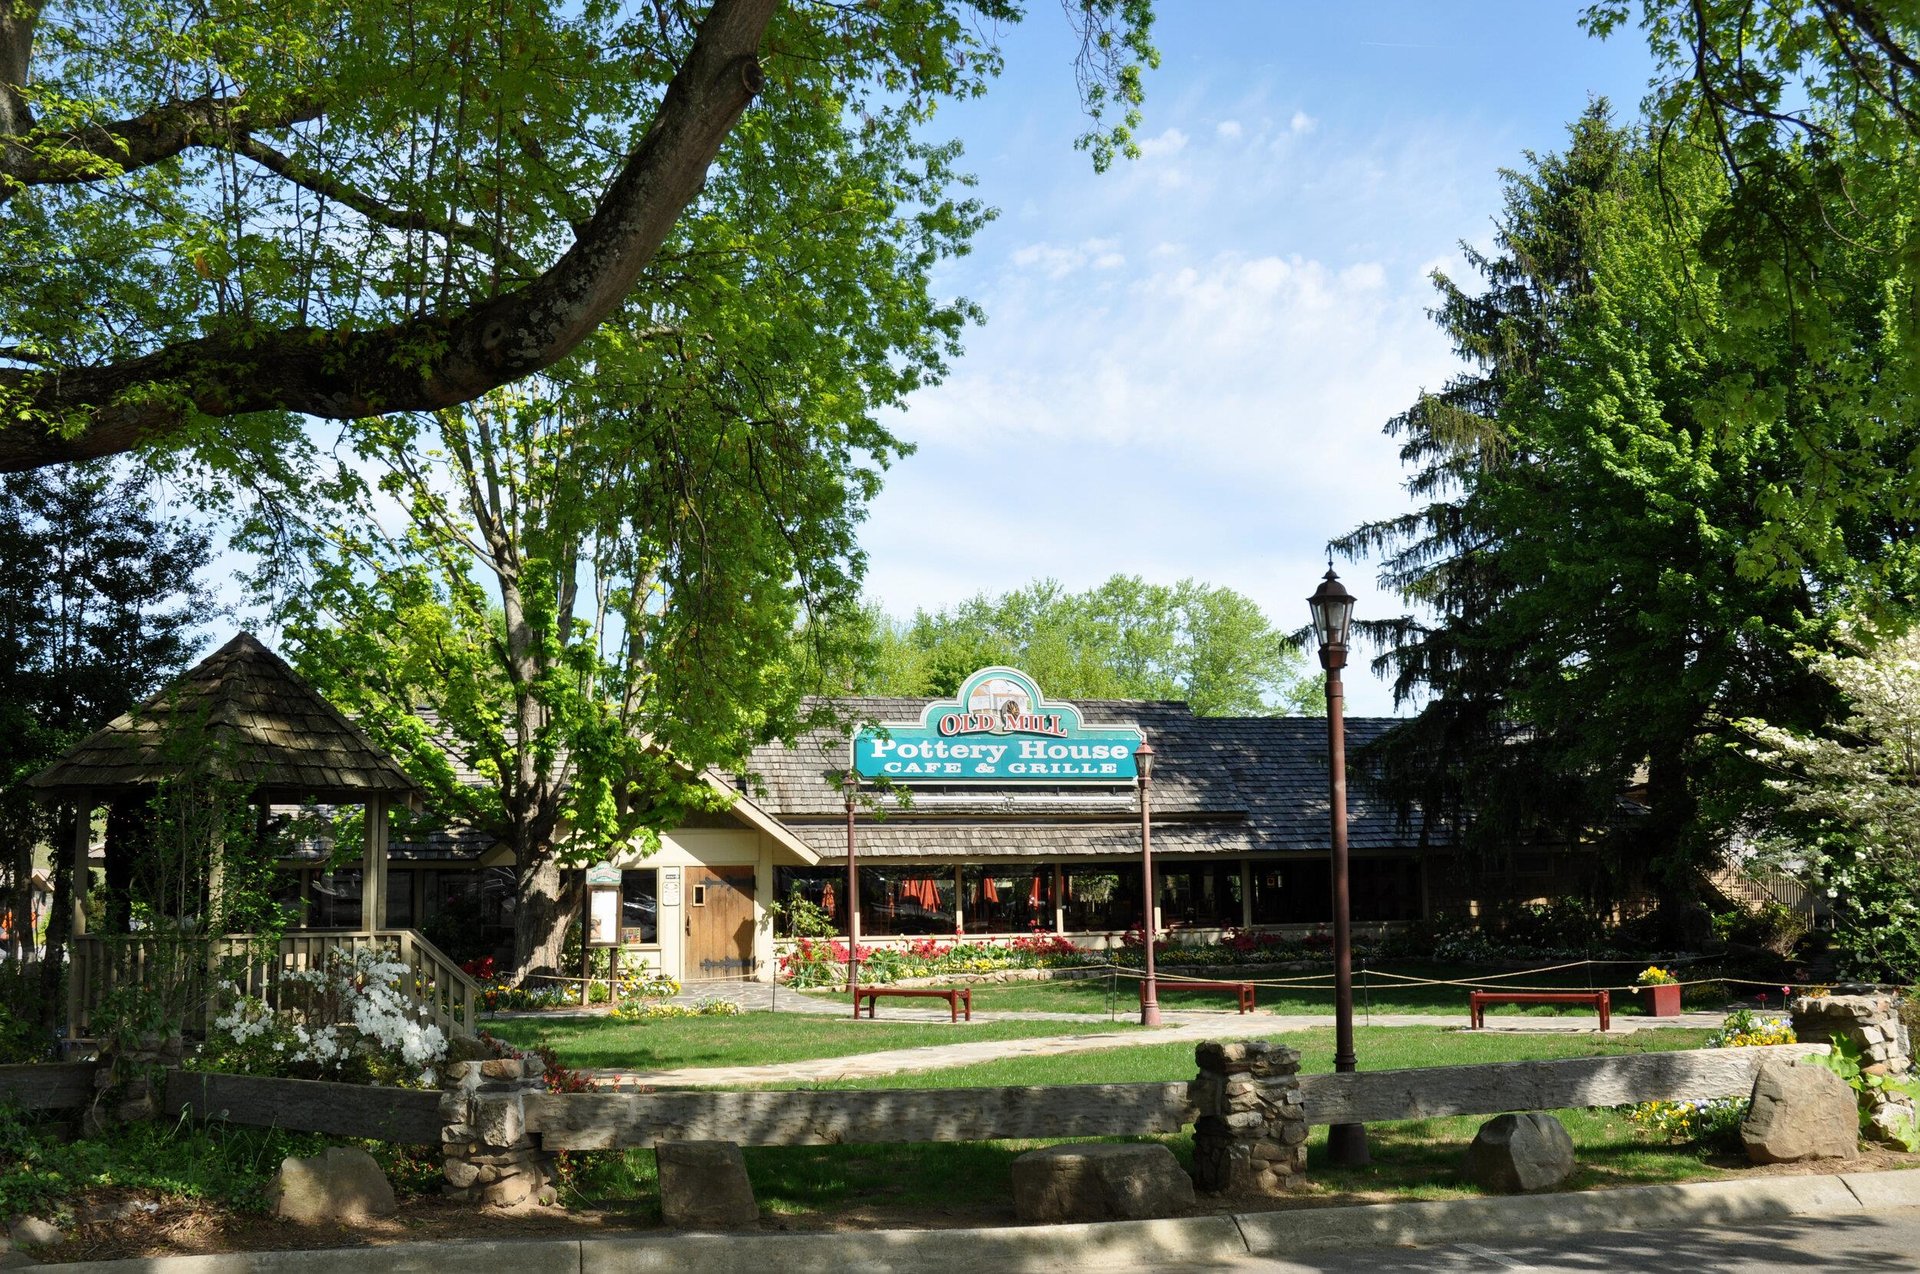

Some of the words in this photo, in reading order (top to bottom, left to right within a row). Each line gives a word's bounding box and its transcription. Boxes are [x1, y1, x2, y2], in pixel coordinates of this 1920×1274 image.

[940, 713, 995, 736] OLD
[1003, 713, 1068, 738] MILL
[870, 739, 1008, 763] Pottery
[1018, 740, 1129, 760] House
[884, 762, 962, 774] CAFE
[975, 762, 996, 774] &
[1008, 762, 1117, 774] GRILLE
